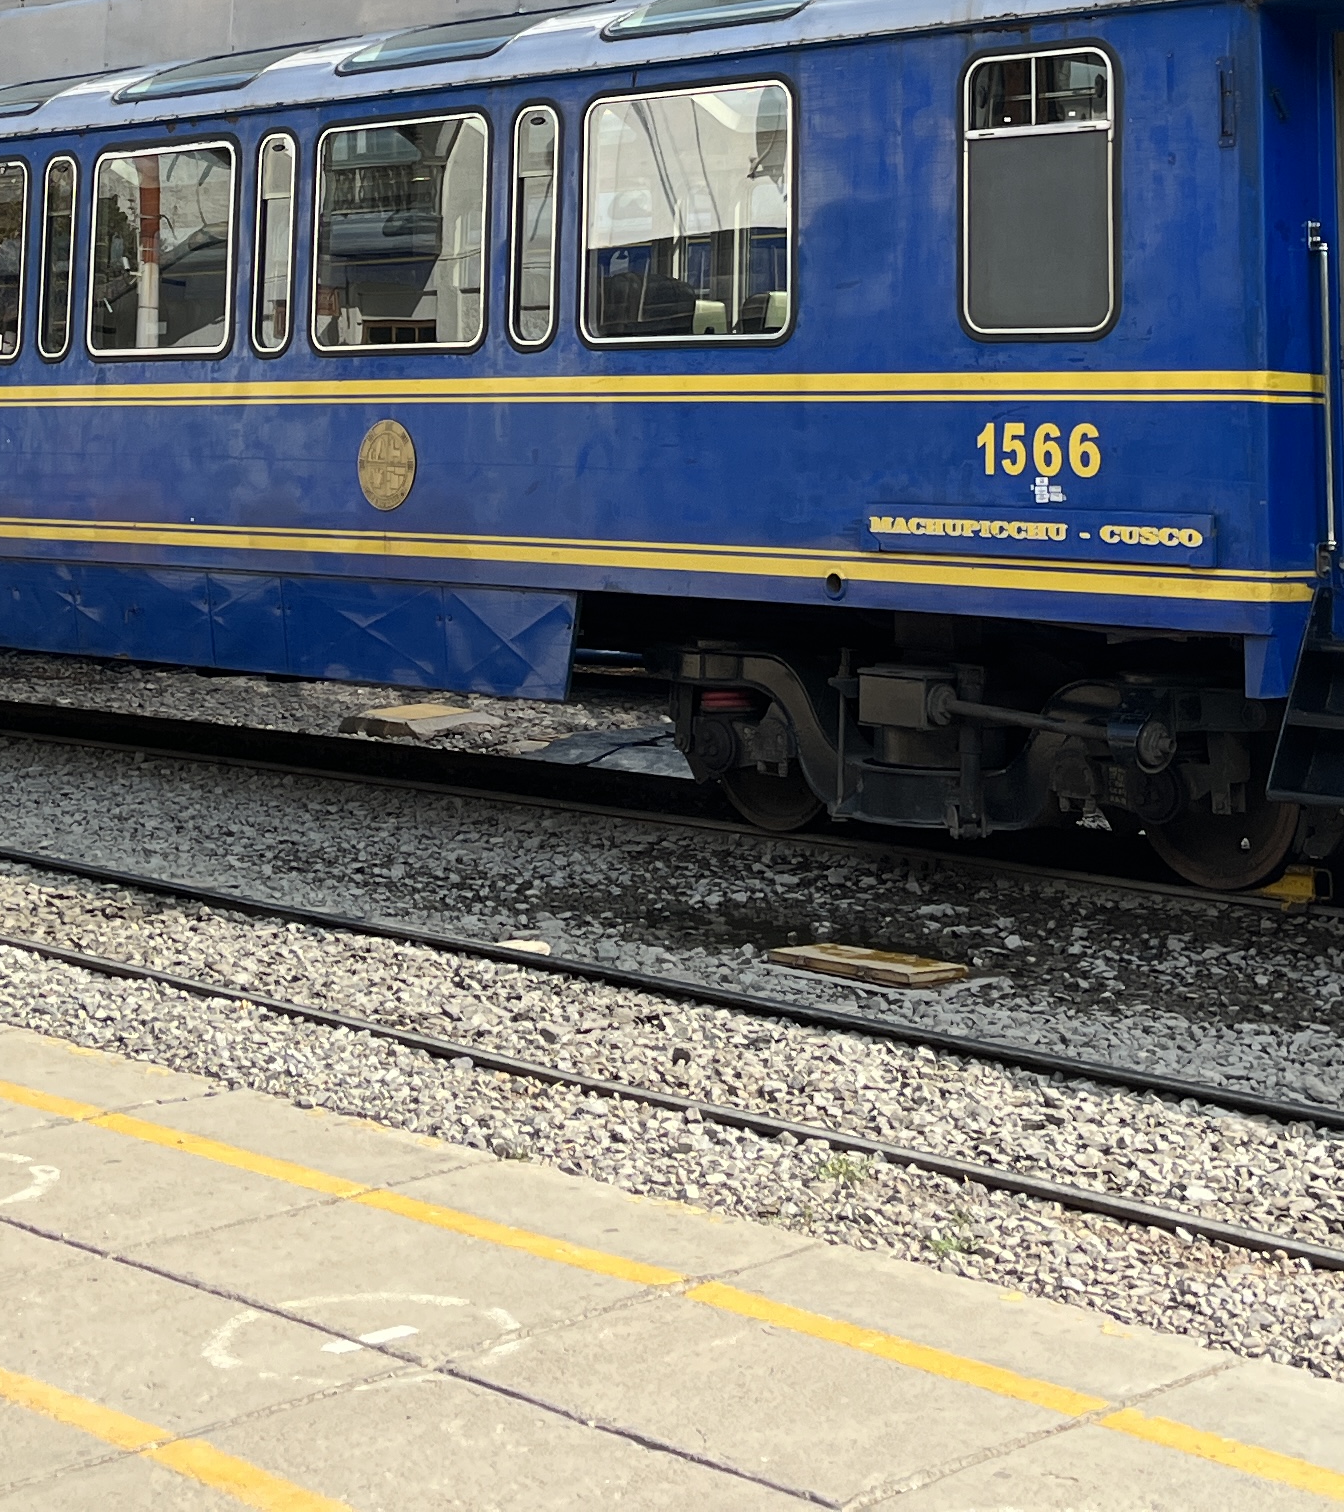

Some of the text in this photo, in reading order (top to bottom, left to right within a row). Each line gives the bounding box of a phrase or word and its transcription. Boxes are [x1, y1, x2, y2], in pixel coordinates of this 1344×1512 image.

[976, 422, 1101, 478] 1566
[869, 515, 1068, 541] MACHUPICCHU
[1099, 524, 1203, 548] CUSCO
